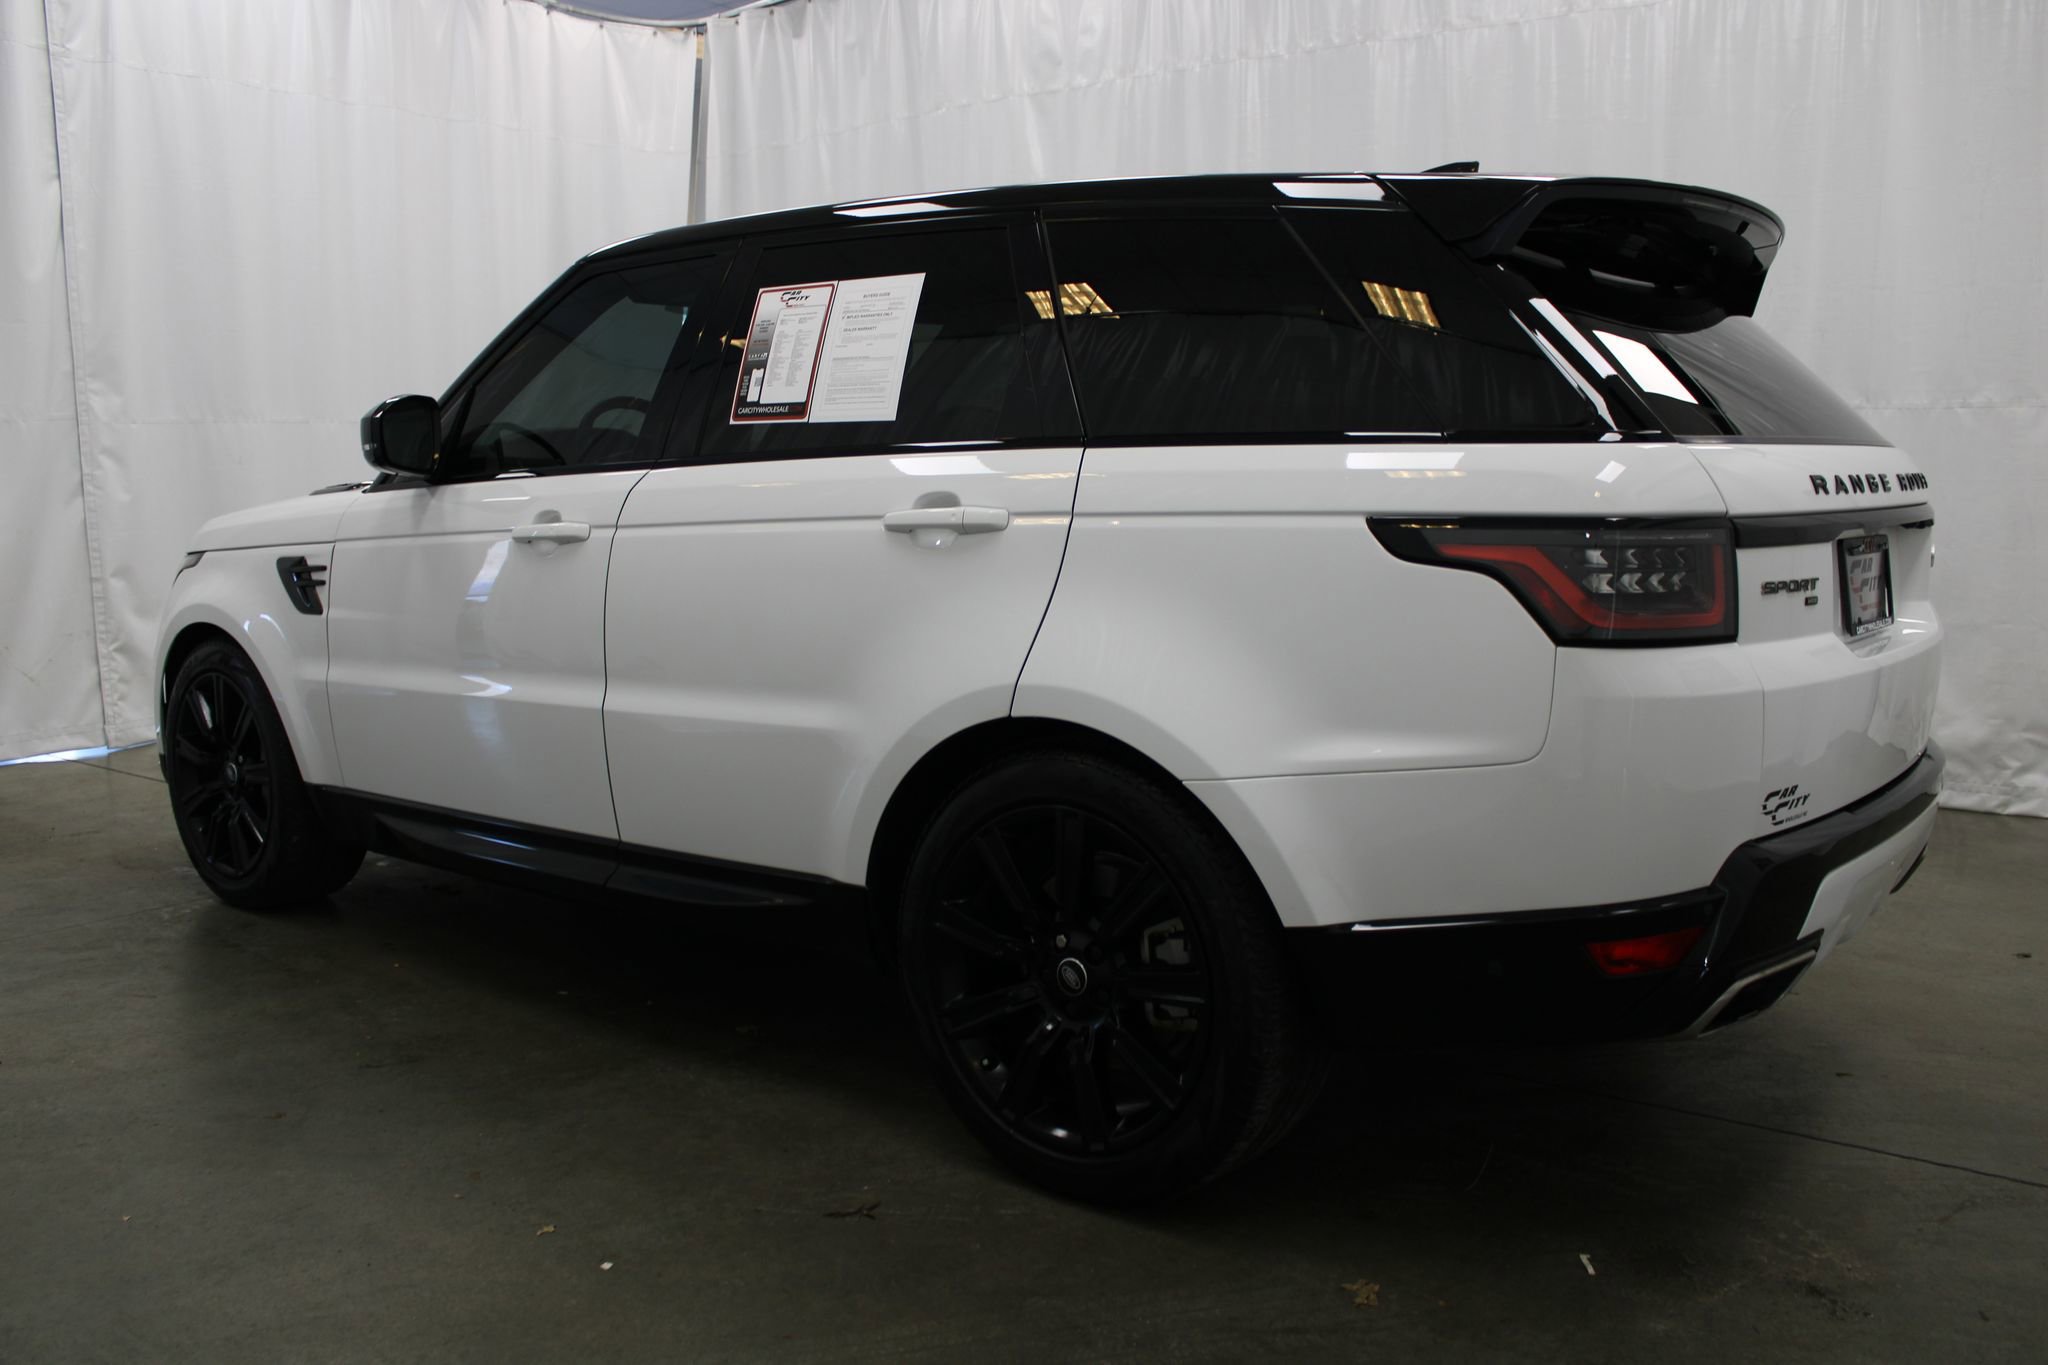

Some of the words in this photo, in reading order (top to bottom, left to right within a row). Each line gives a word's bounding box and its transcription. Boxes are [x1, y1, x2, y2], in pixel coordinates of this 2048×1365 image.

[781, 290, 802, 303] CAR
[786, 295, 810, 308] CITY
[1809, 473, 1892, 495] RANGE
[1761, 577, 1819, 595] SPORT
[1762, 784, 1799, 816] CAR
[1771, 793, 1811, 826] CITY
